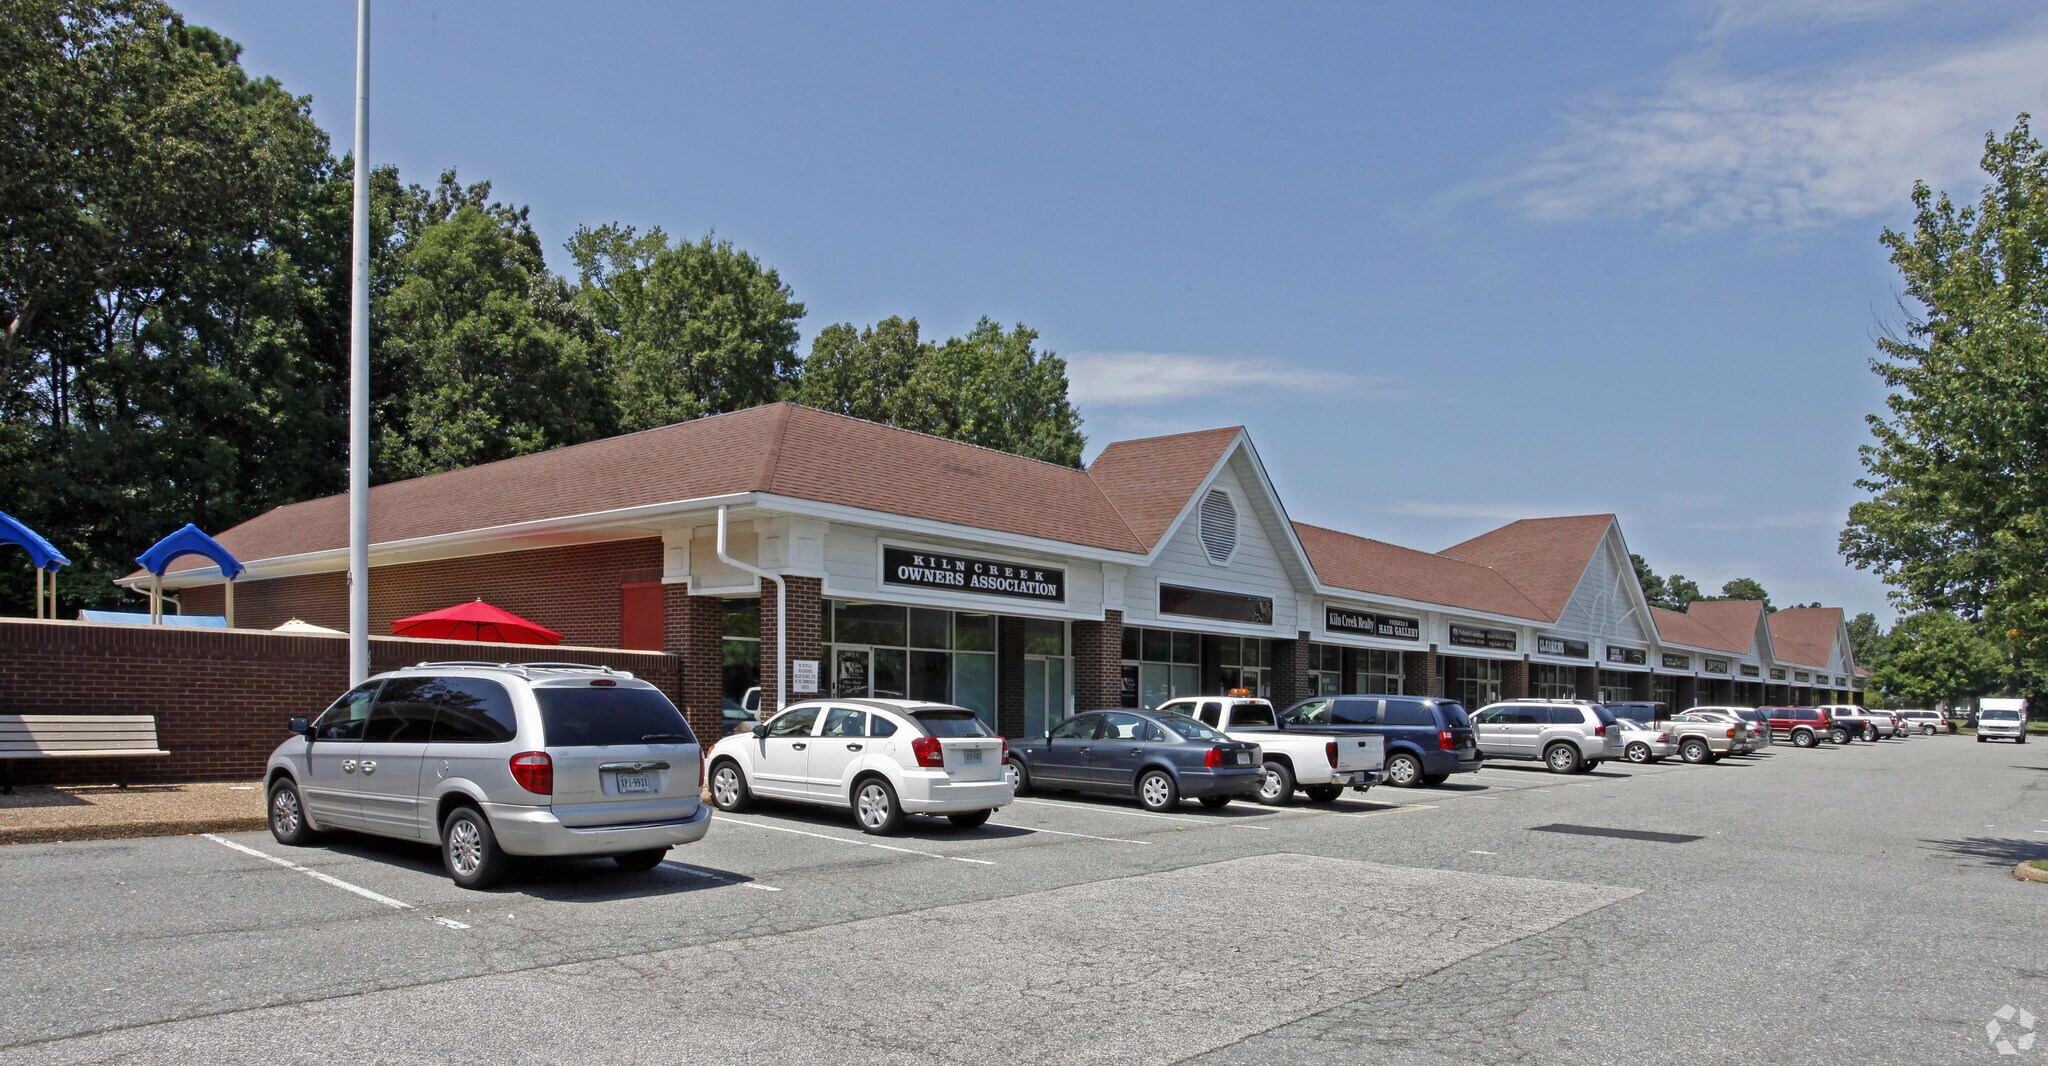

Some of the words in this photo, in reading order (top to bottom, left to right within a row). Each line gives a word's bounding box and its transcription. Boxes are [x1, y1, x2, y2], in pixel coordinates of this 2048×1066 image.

[913, 555, 965, 572] KILN
[974, 563, 1044, 581] CREEK
[898, 565, 965, 586] OWNERS
[970, 575, 1057, 597] ASSOCIATION
[1329, 612, 1342, 626] Kiln
[1342, 614, 1358, 628] Creek
[1358, 616, 1374, 633] Realty
[1379, 624, 1394, 635] HAIR
[1394, 626, 1419, 638] GALLERY
[1539, 639, 1564, 654] CLEANERS
